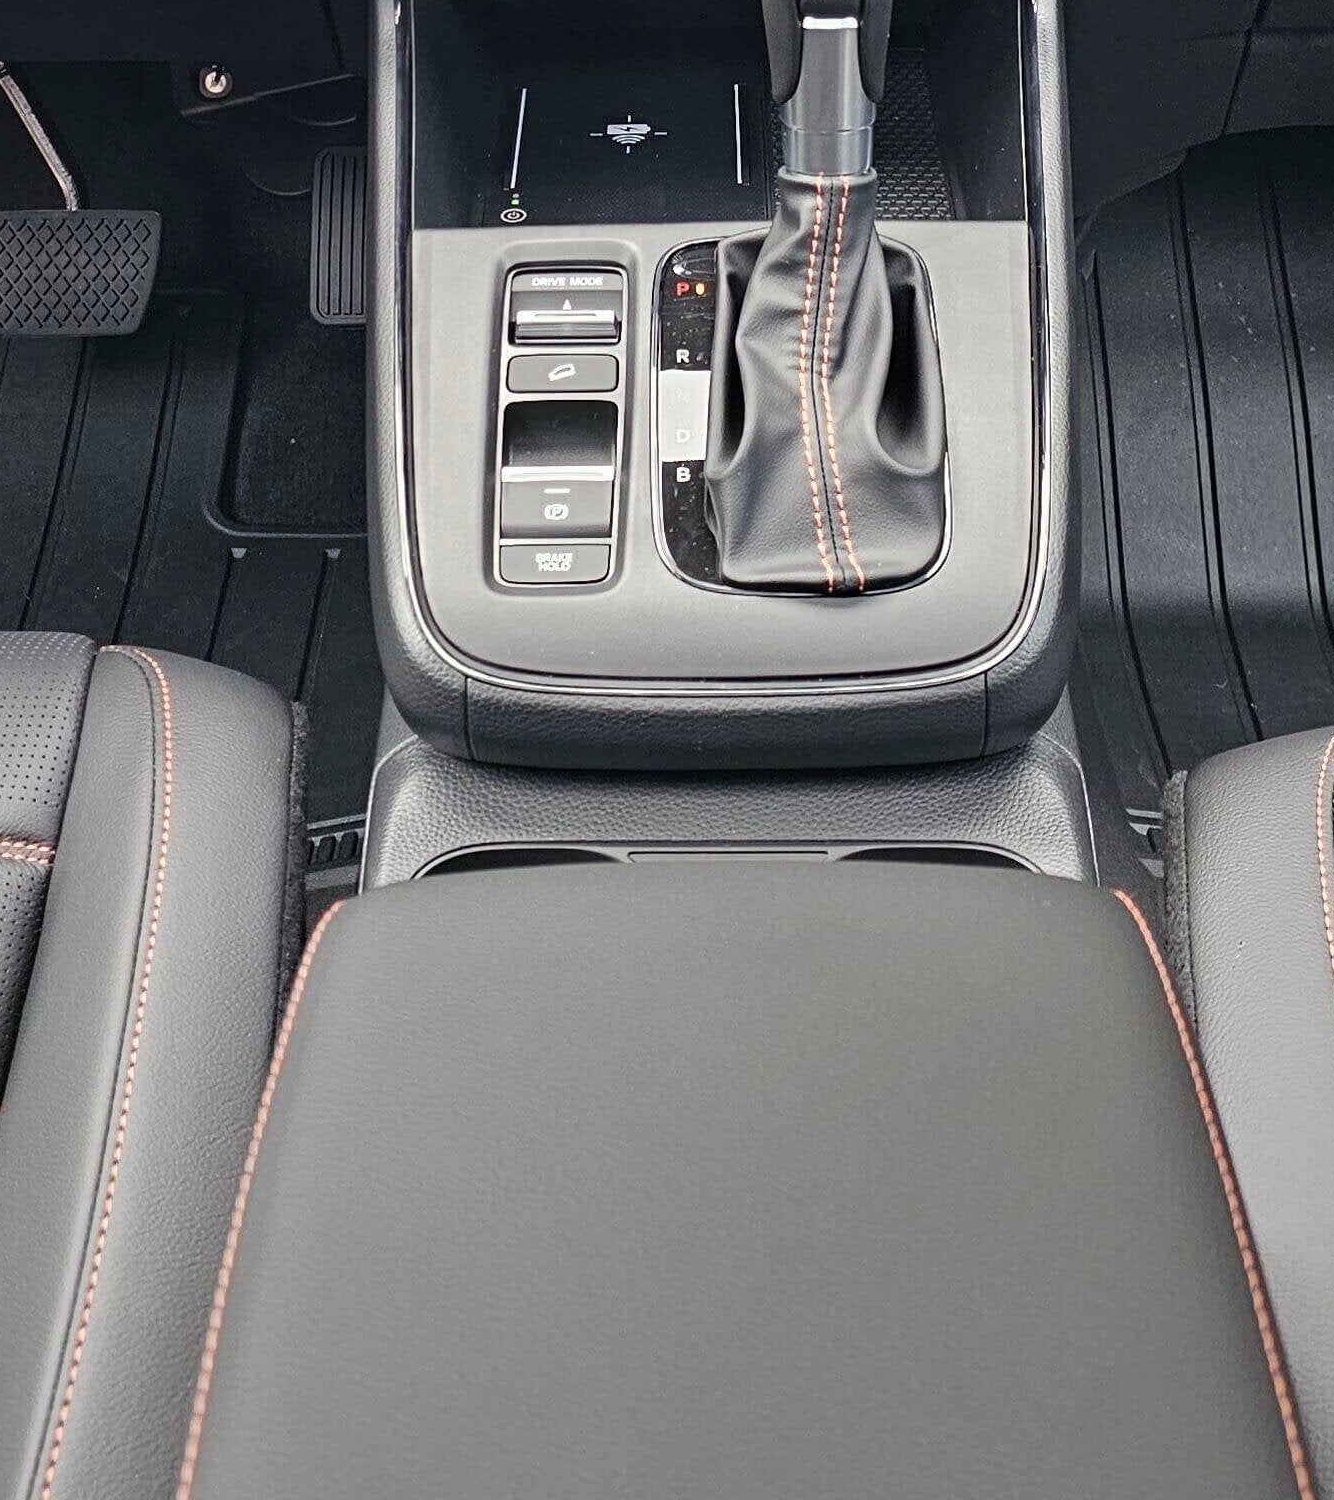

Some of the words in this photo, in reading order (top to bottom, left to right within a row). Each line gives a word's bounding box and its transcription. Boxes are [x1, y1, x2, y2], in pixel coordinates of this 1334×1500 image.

[531, 276, 566, 286] DRIVE
[569, 276, 604, 286] MODE
[676, 282, 691, 297] P
[676, 348, 690, 364] R
[676, 466, 692, 483] B
[538, 562, 572, 572] HOLD
